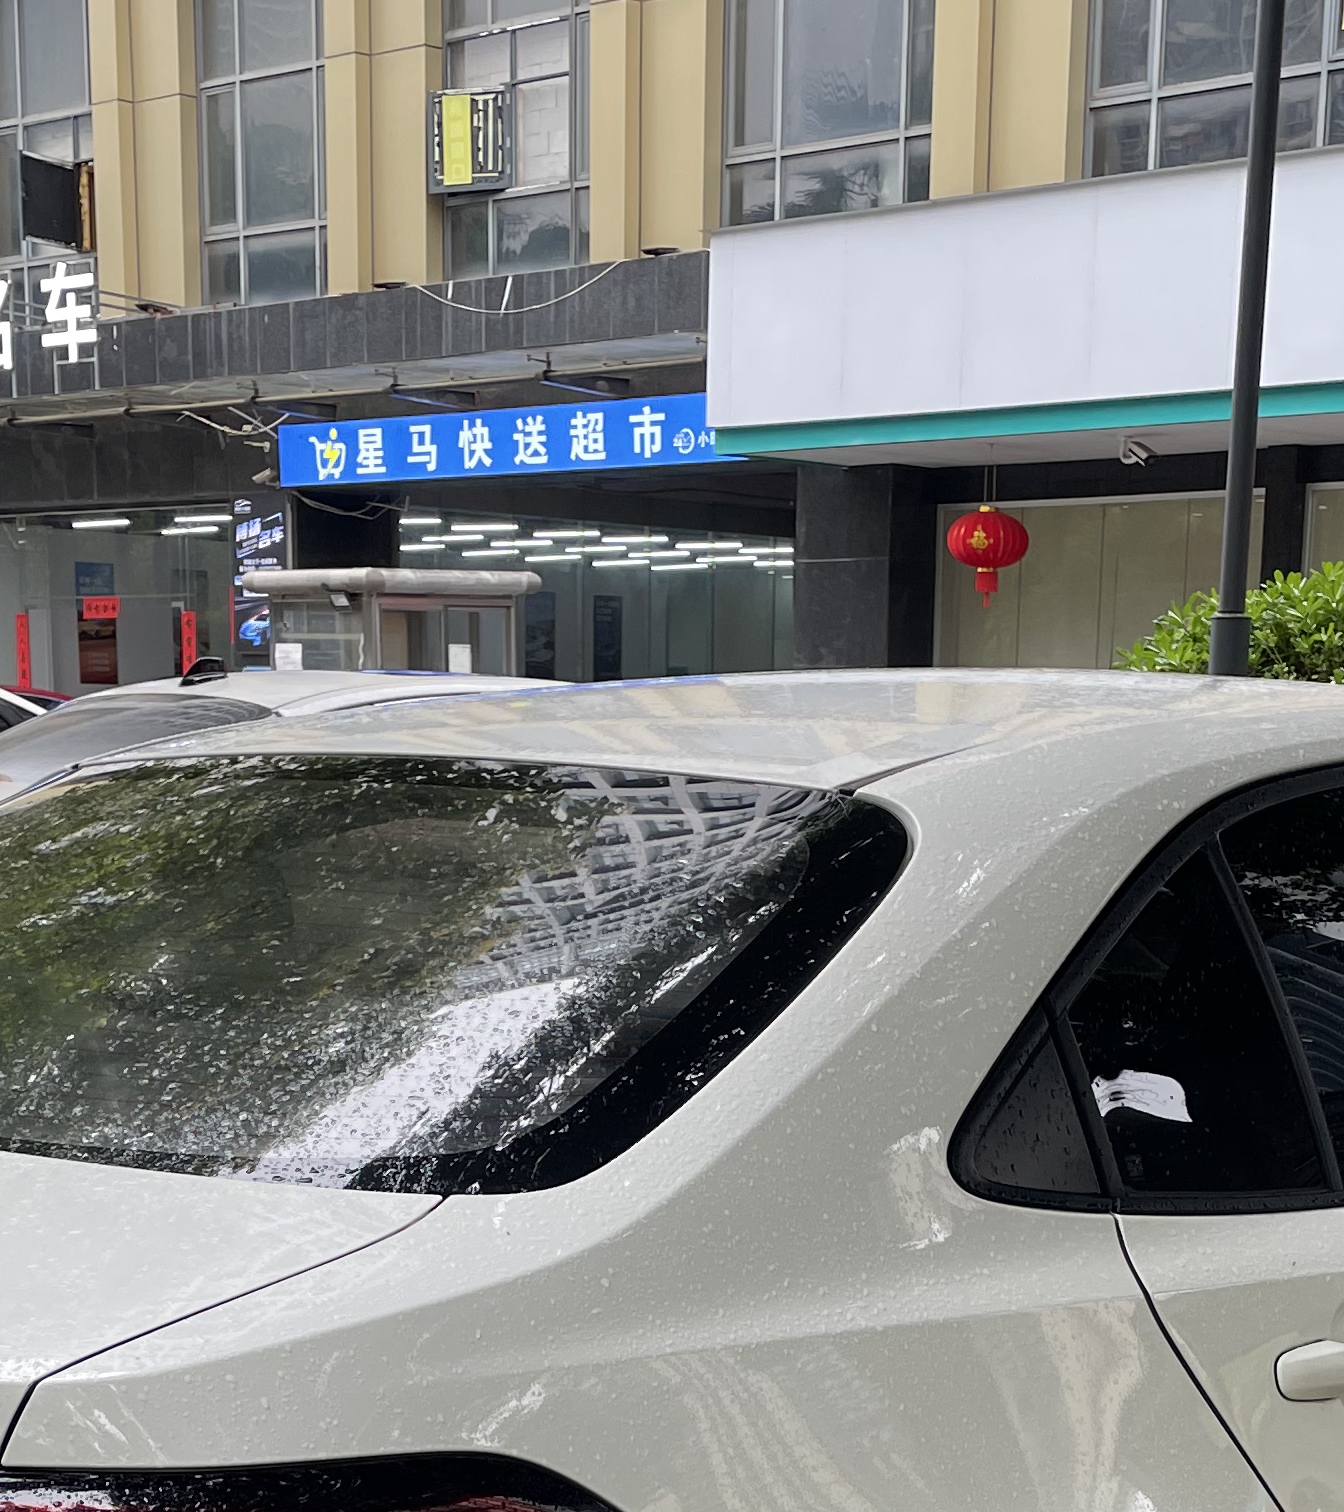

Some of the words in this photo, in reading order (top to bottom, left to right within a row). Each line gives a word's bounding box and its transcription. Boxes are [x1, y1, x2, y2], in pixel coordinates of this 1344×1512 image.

[356, 406, 665, 475] 星马快送超市
